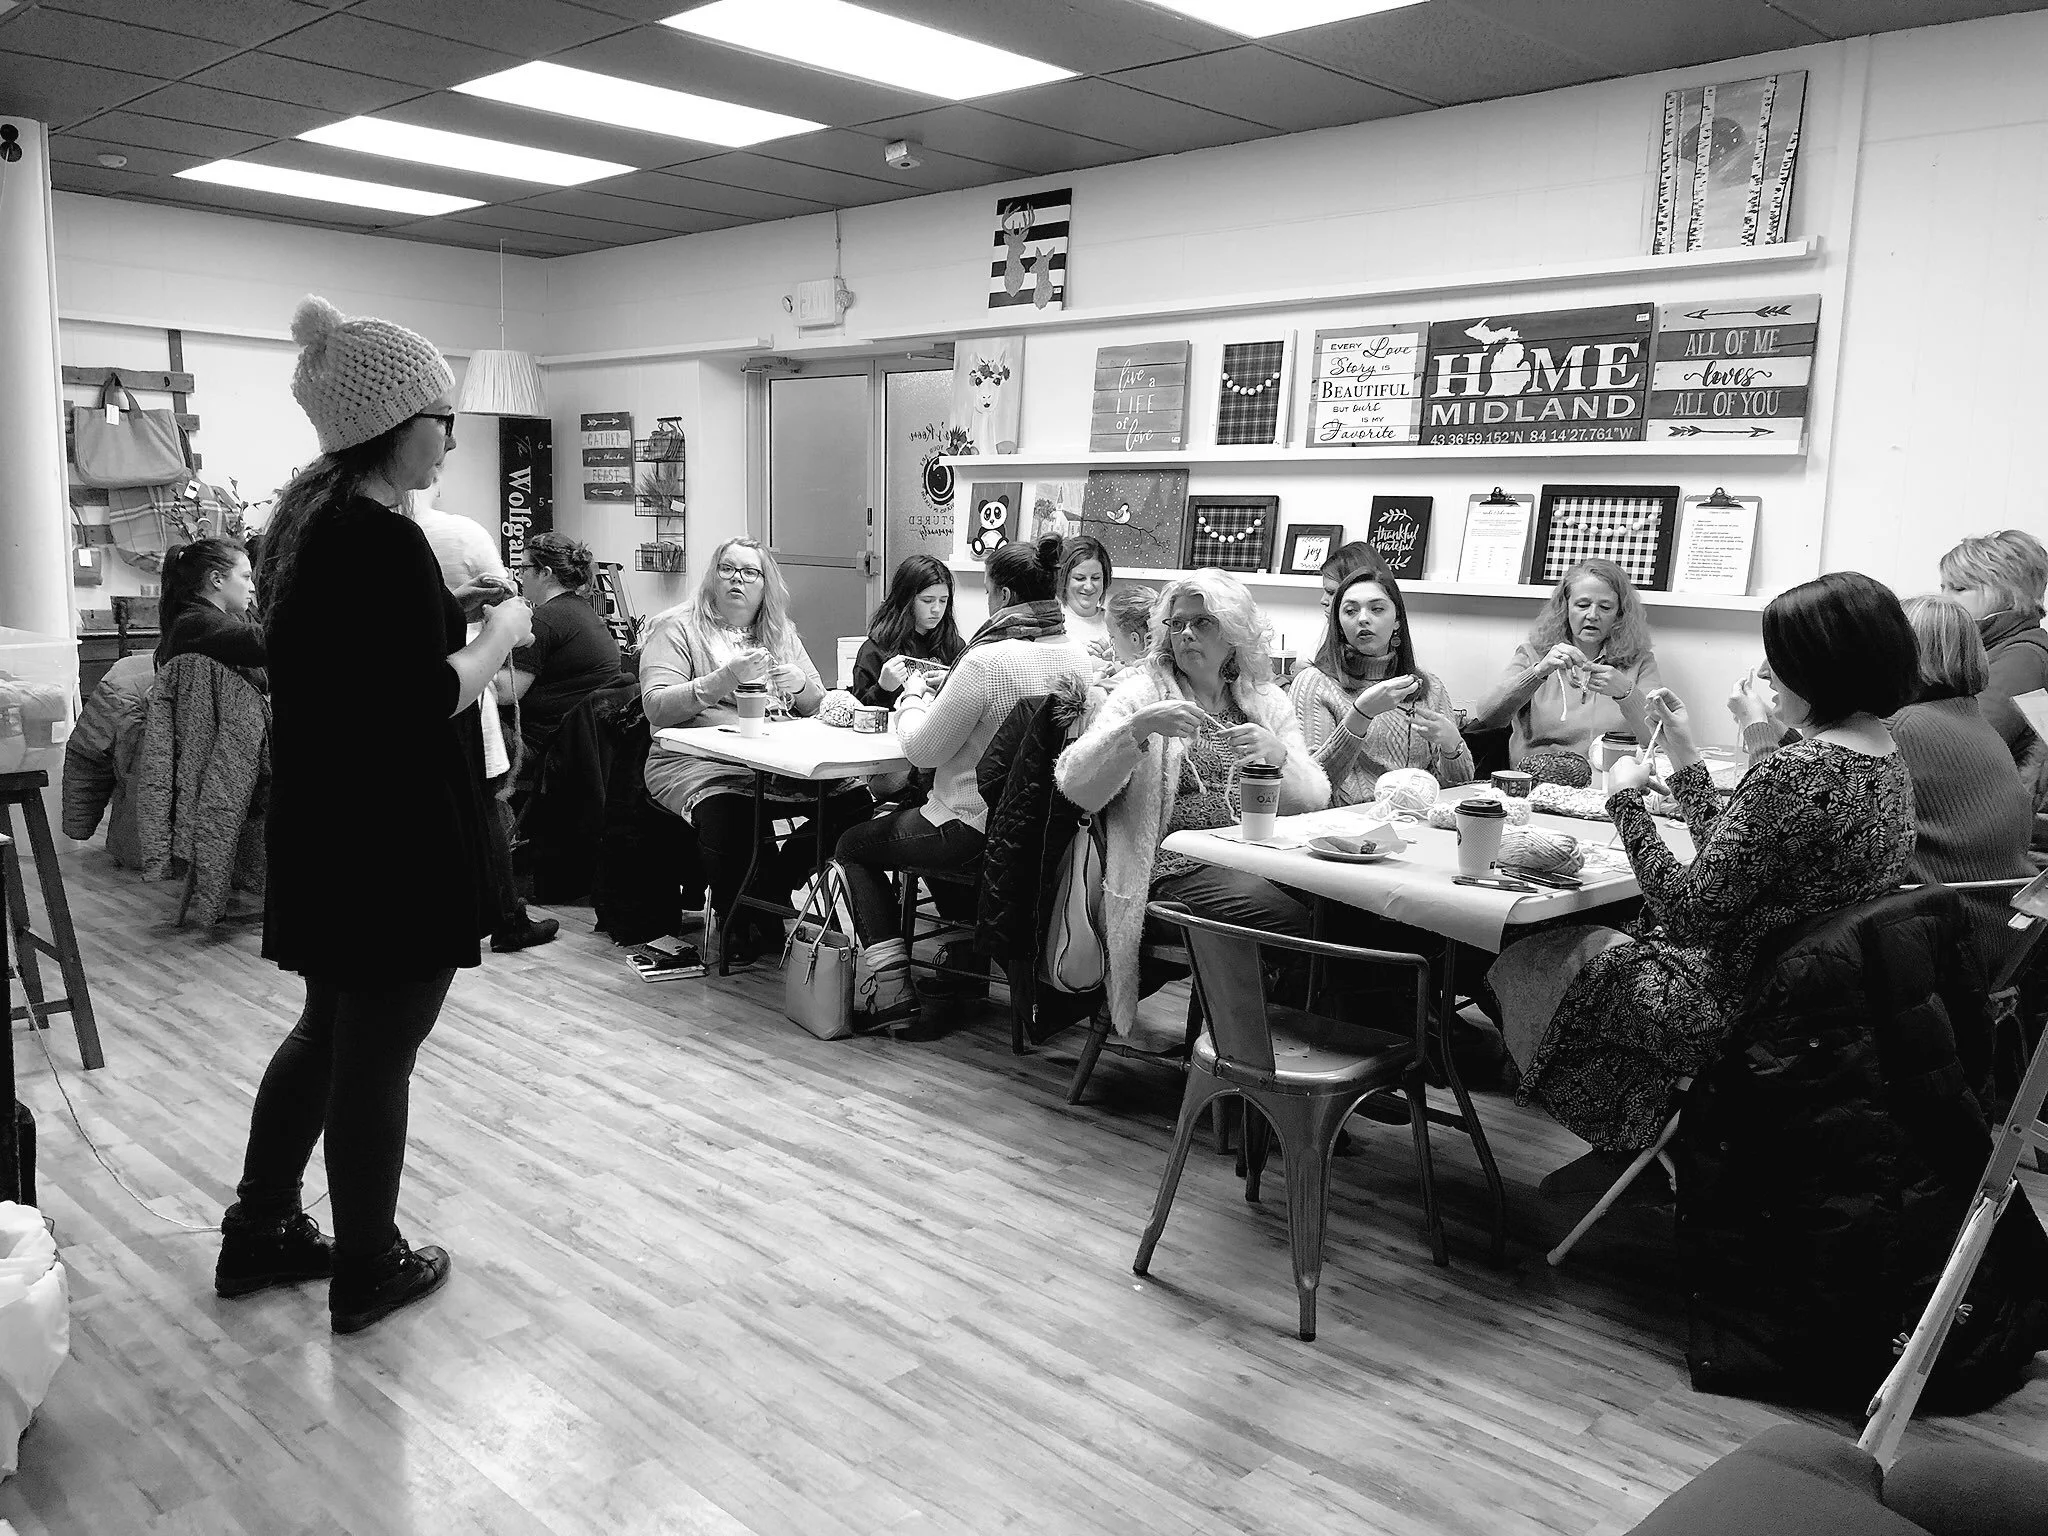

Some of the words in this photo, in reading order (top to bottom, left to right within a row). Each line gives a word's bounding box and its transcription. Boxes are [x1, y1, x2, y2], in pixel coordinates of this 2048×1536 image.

[1363, 337, 1412, 358] Love
[1684, 332, 1720, 357] ALL
[1725, 330, 1749, 356] OF
[1752, 329, 1780, 354] ME
[1119, 358, 1145, 393] live
[1149, 377, 1156, 387] a
[1330, 357, 1376, 382] Story
[1690, 361, 1766, 387] loves
[1322, 381, 1410, 398] BEAUTIFUL
[1116, 394, 1155, 414] LIFE
[1430, 395, 1636, 426] MIDLAND
[1672, 393, 1708, 416] ALL
[1713, 391, 1738, 416] OF
[1740, 390, 1781, 416] YOU
[1116, 417, 1129, 429] of
[1320, 419, 1396, 441] Favorite
[537, 441, 544, 449] 6
[587, 433, 621, 446] GATHER
[1126, 418, 1154, 452] love
[1430, 434, 1446, 445] 43
[1530, 430, 1546, 442] 84
[592, 469, 620, 481] FEAST
[538, 497, 545, 507] 5
[1374, 523, 1419, 543] thankful
[1303, 545, 1322, 562] joy
[1376, 539, 1414, 556] grateful
